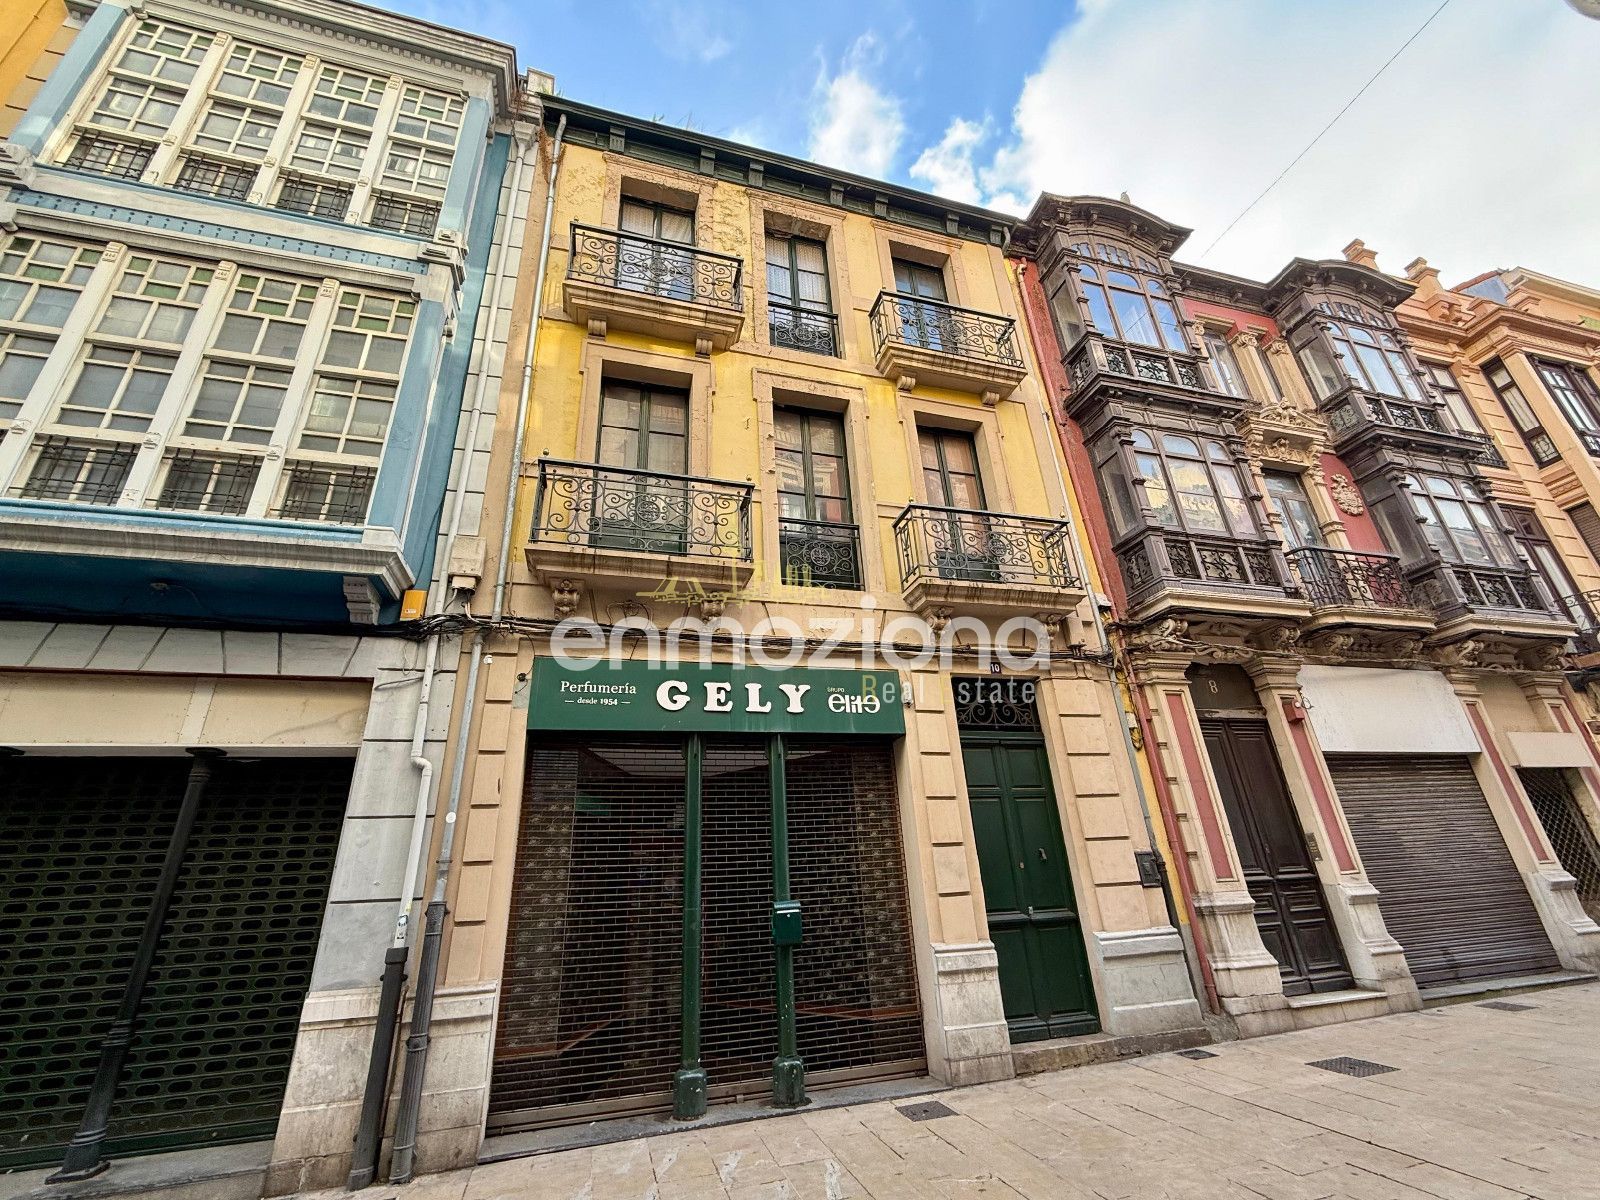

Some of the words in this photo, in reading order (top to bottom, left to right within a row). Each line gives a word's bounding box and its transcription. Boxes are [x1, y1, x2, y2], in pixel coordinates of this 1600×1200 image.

[991, 663, 1000, 672] 10
[560, 681, 636, 694] Perfumería
[1209, 680, 1218, 693] 8
[577, 697, 598, 705] desde
[600, 698, 618, 706] 1954
[656, 680, 811, 713] GELY
[828, 693, 881, 714] elite
